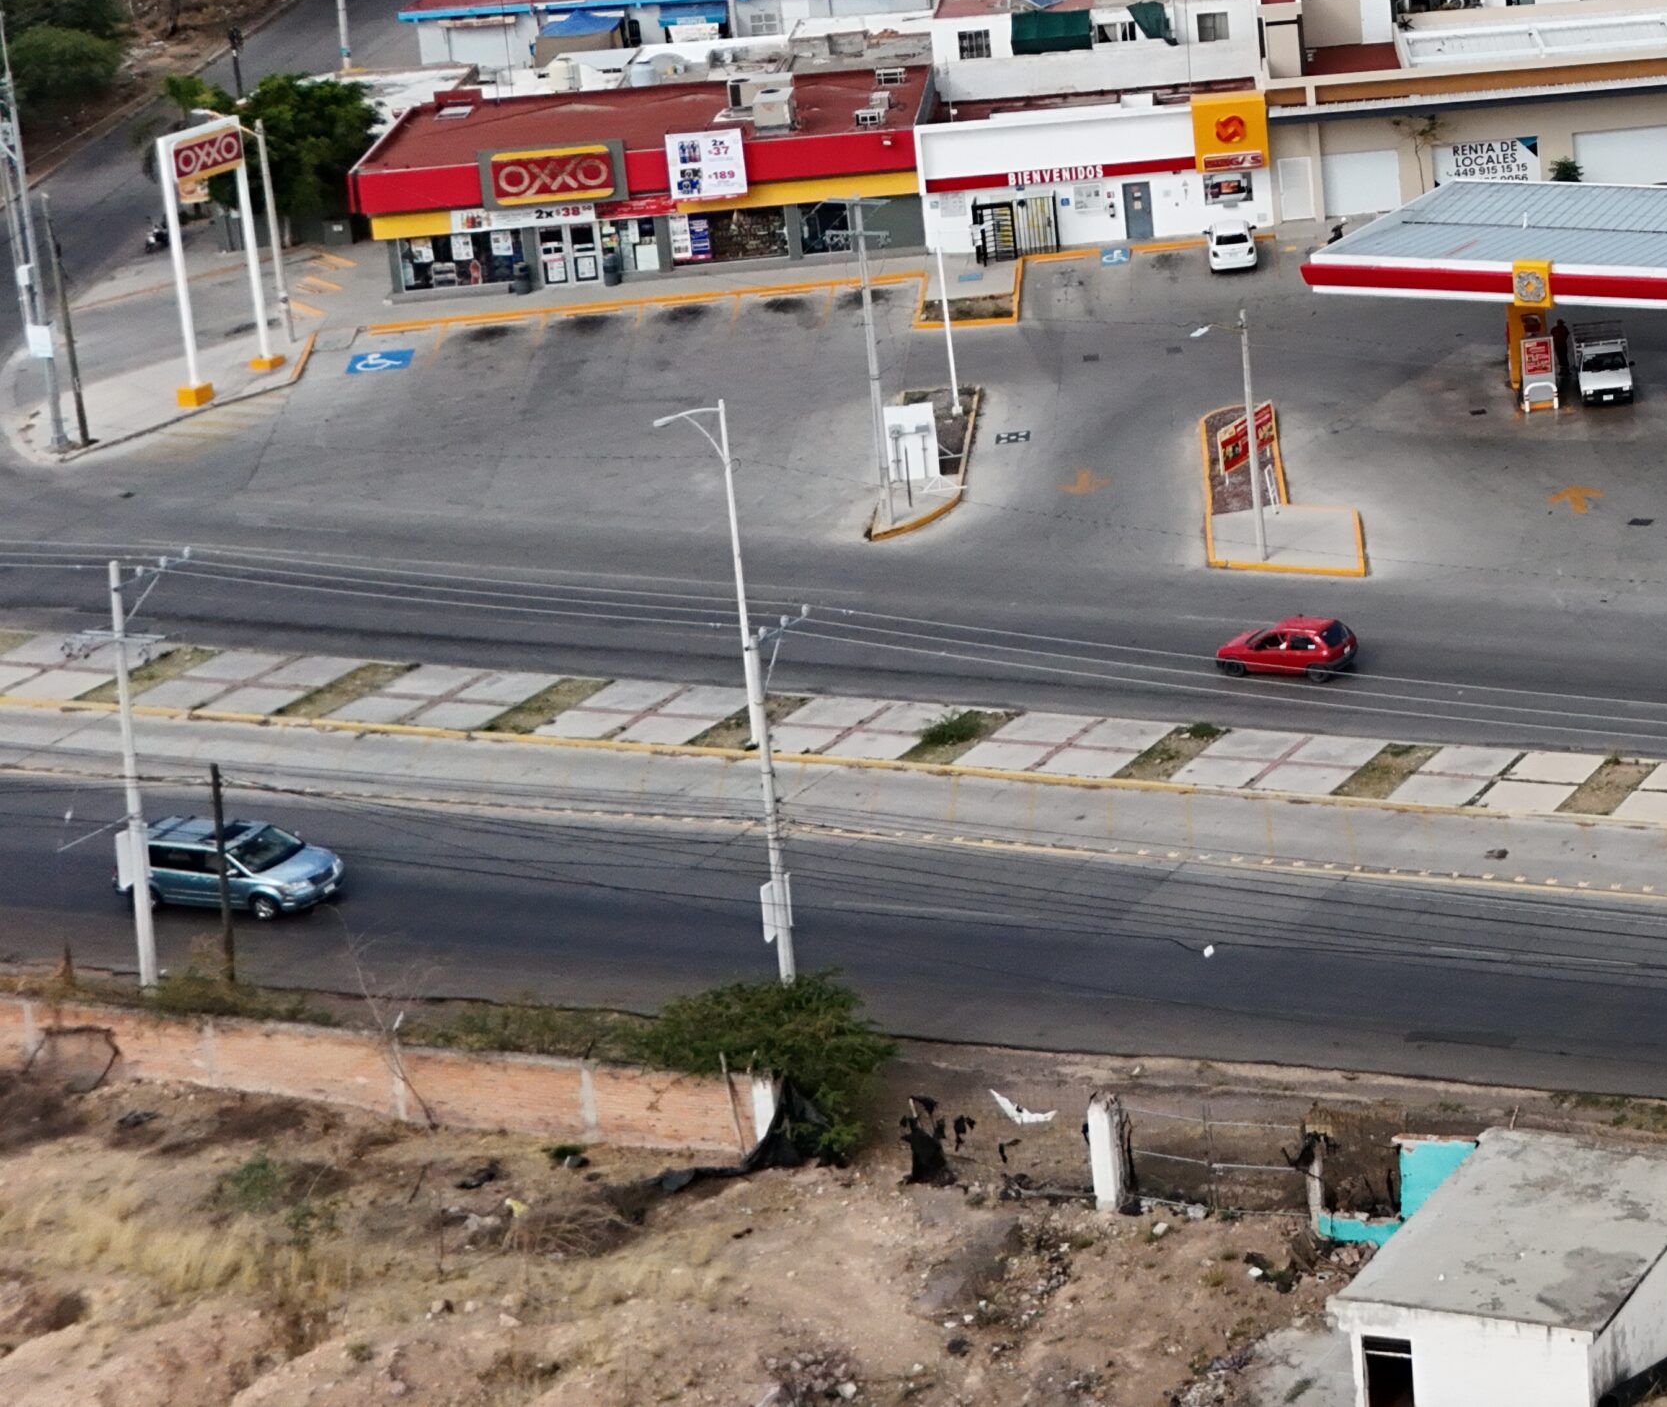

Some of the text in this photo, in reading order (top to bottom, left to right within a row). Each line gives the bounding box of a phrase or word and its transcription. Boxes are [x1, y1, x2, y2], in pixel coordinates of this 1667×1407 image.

[178, 135, 238, 174] OXXO
[1453, 141, 1517, 156] RENTA DE
[1455, 153, 1517, 167] LOCALES
[498, 155, 608, 196] OXXO
[1007, 165, 1104, 186] BIENVENIDOS
[1454, 163, 1527, 177] 449 915 15 15
[535, 209, 553, 219] 2x
